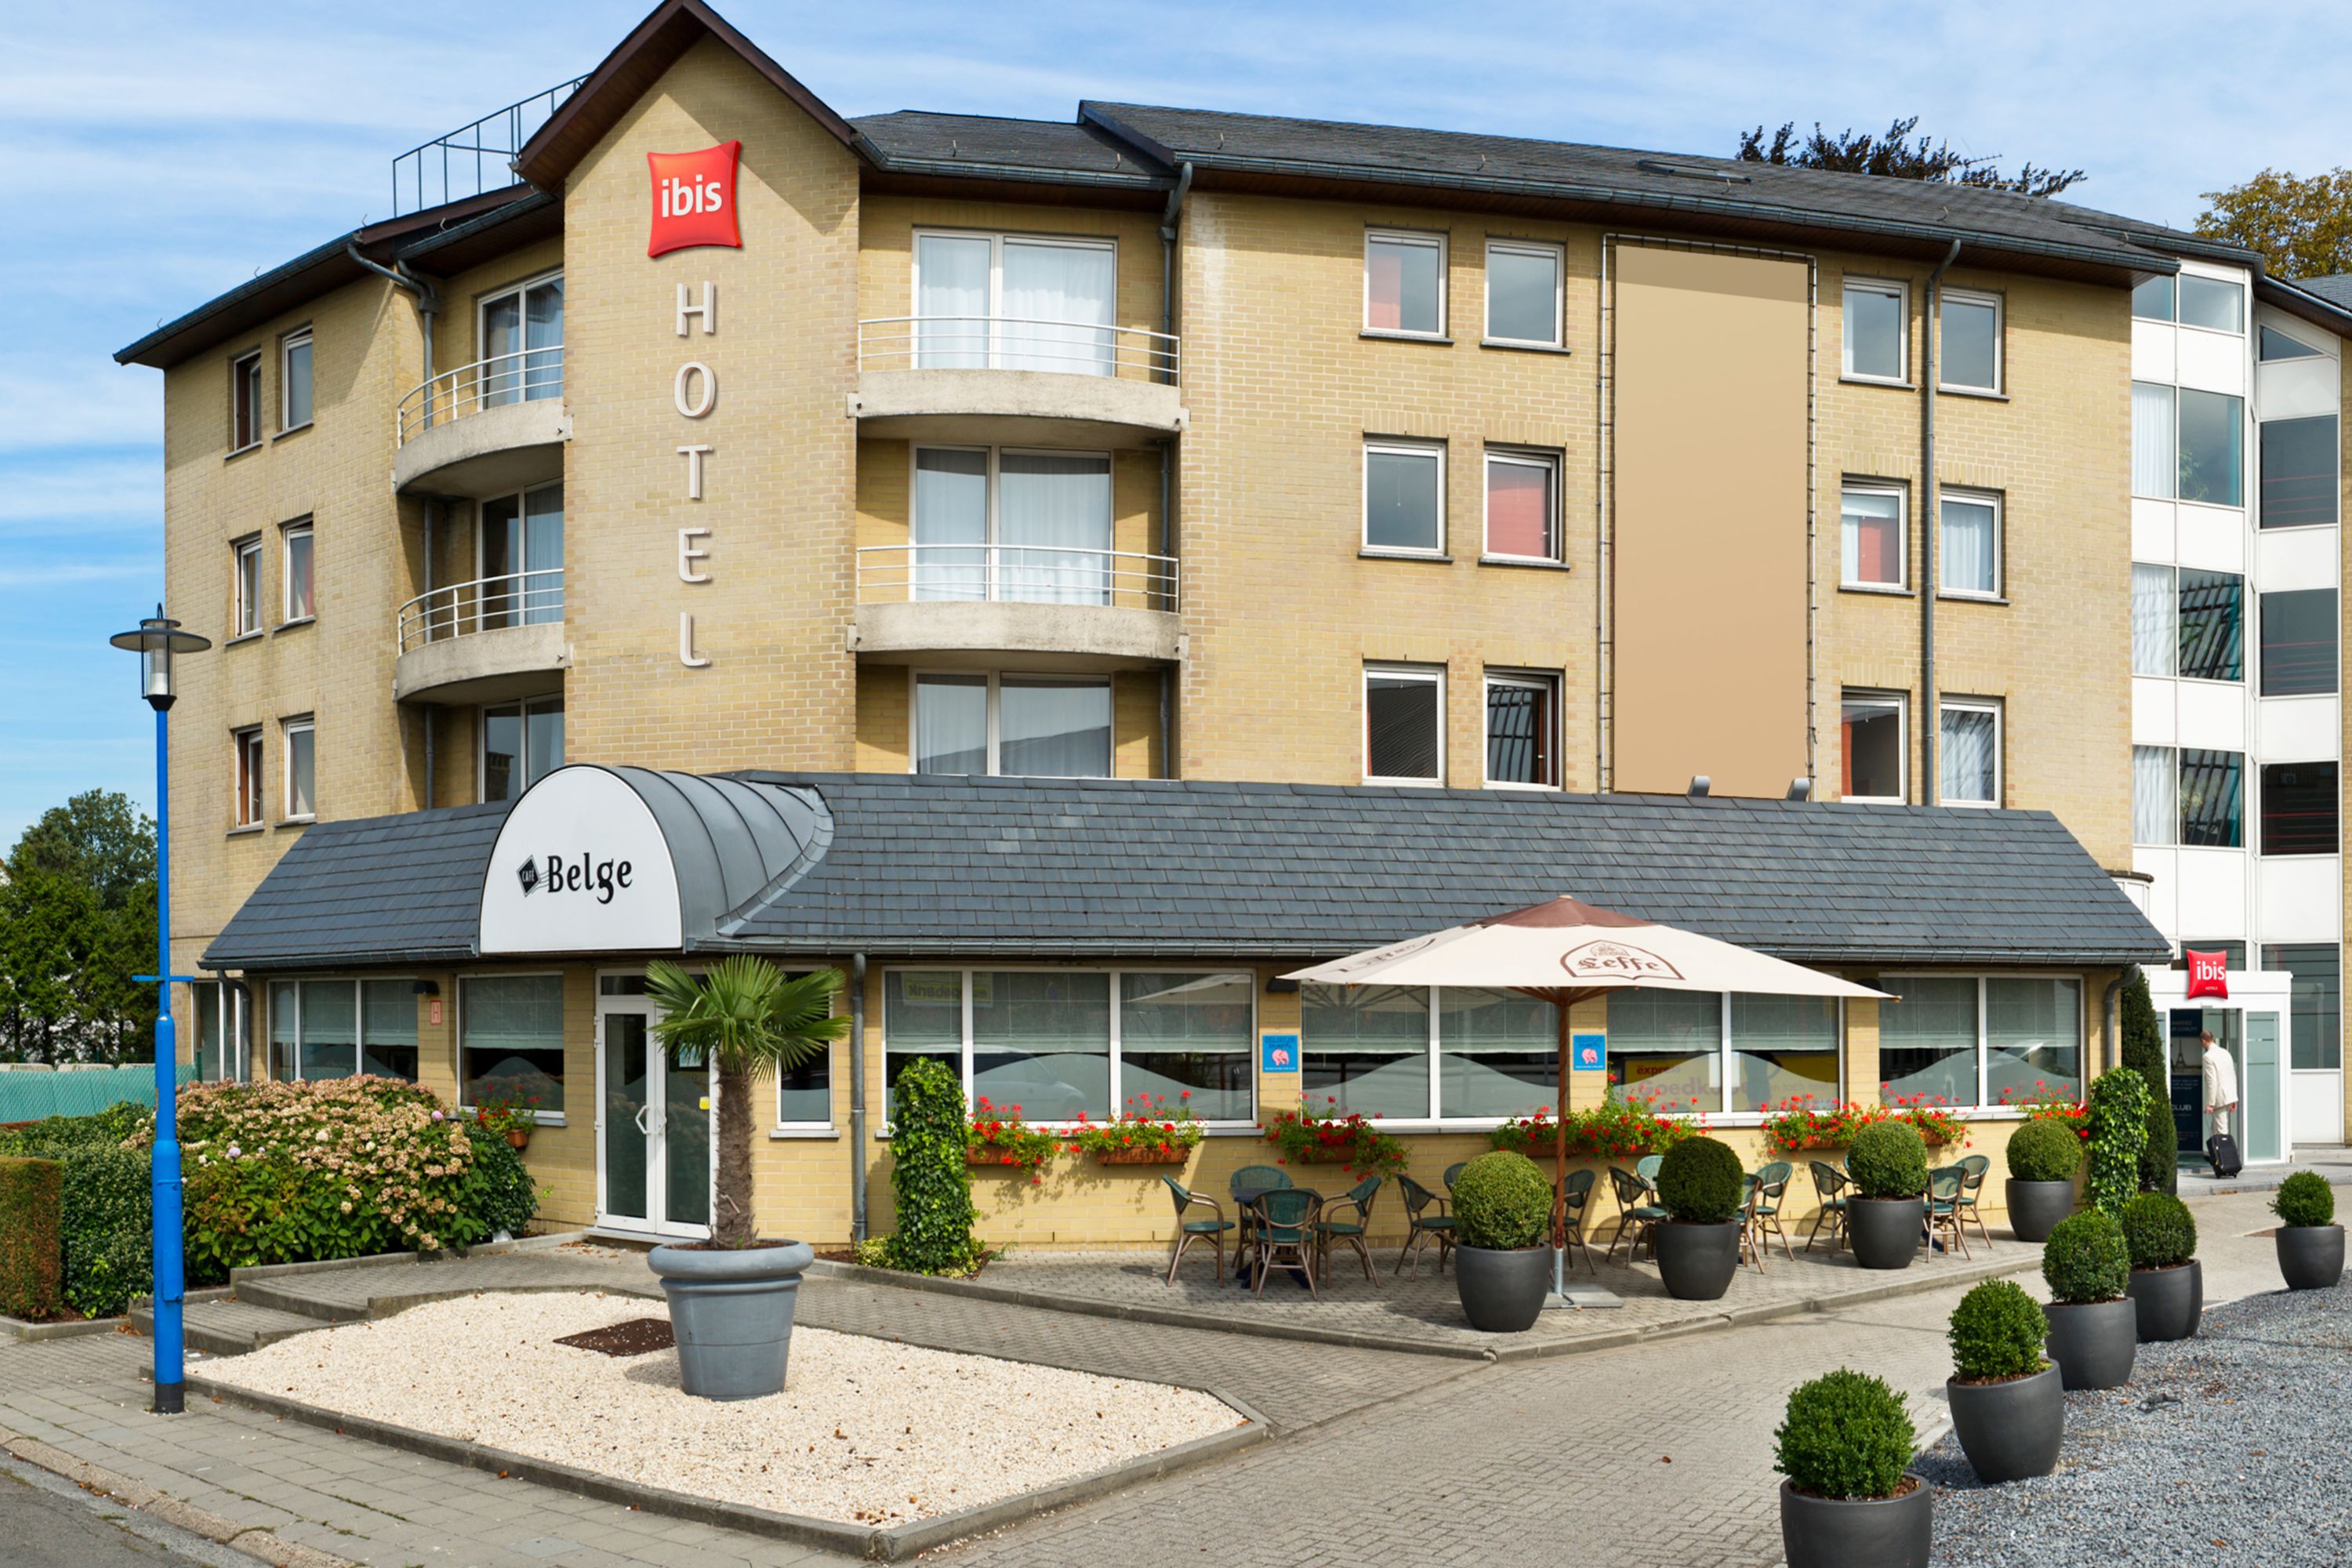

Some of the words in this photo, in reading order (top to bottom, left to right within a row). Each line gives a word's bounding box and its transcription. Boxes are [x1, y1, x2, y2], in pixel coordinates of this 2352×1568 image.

[661, 172, 723, 219] ibis
[674, 280, 716, 668] HOTEL
[547, 851, 633, 905] Belge
[1577, 956, 1662, 971] Leffe
[2196, 960, 2226, 981] ibis
